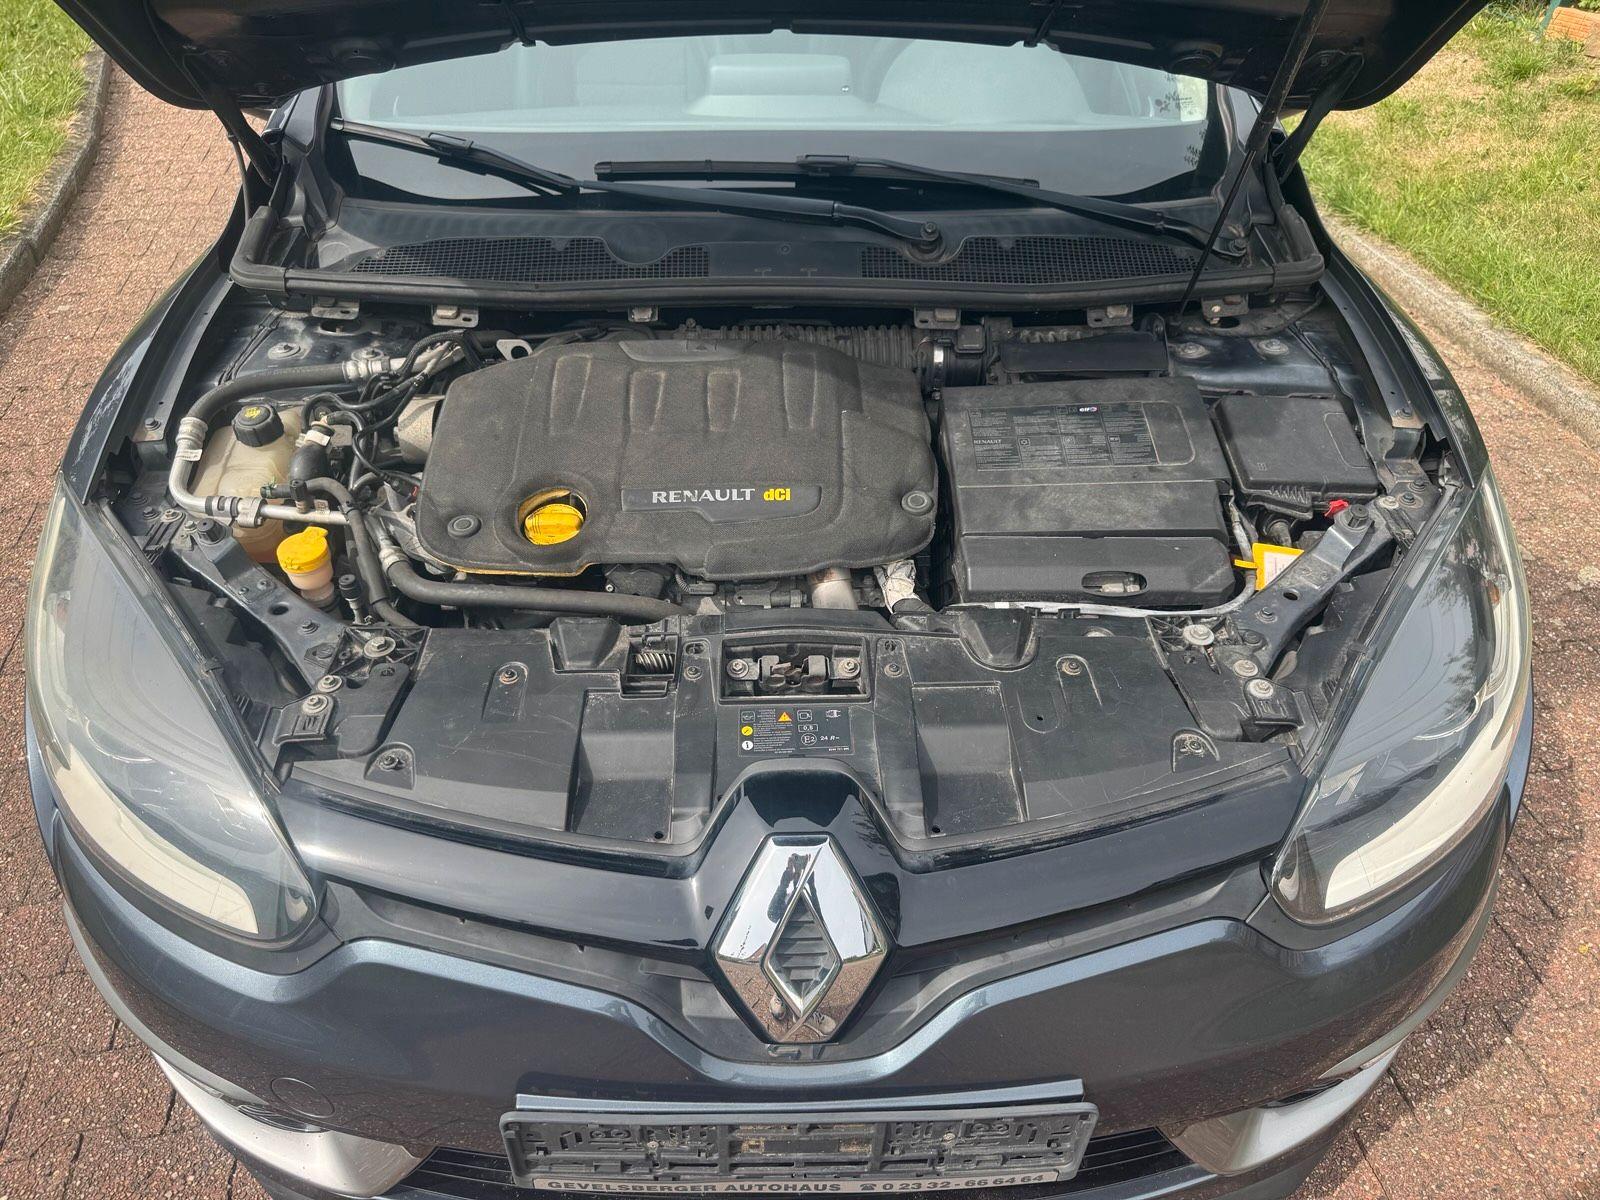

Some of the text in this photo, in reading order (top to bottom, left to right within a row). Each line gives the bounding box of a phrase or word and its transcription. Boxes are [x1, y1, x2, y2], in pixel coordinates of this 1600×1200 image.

[652, 489, 756, 503] RENAULT
[548, 1181, 717, 1192] GEVELSBERGER
[725, 1183, 841, 1192] AUTOHAUS
